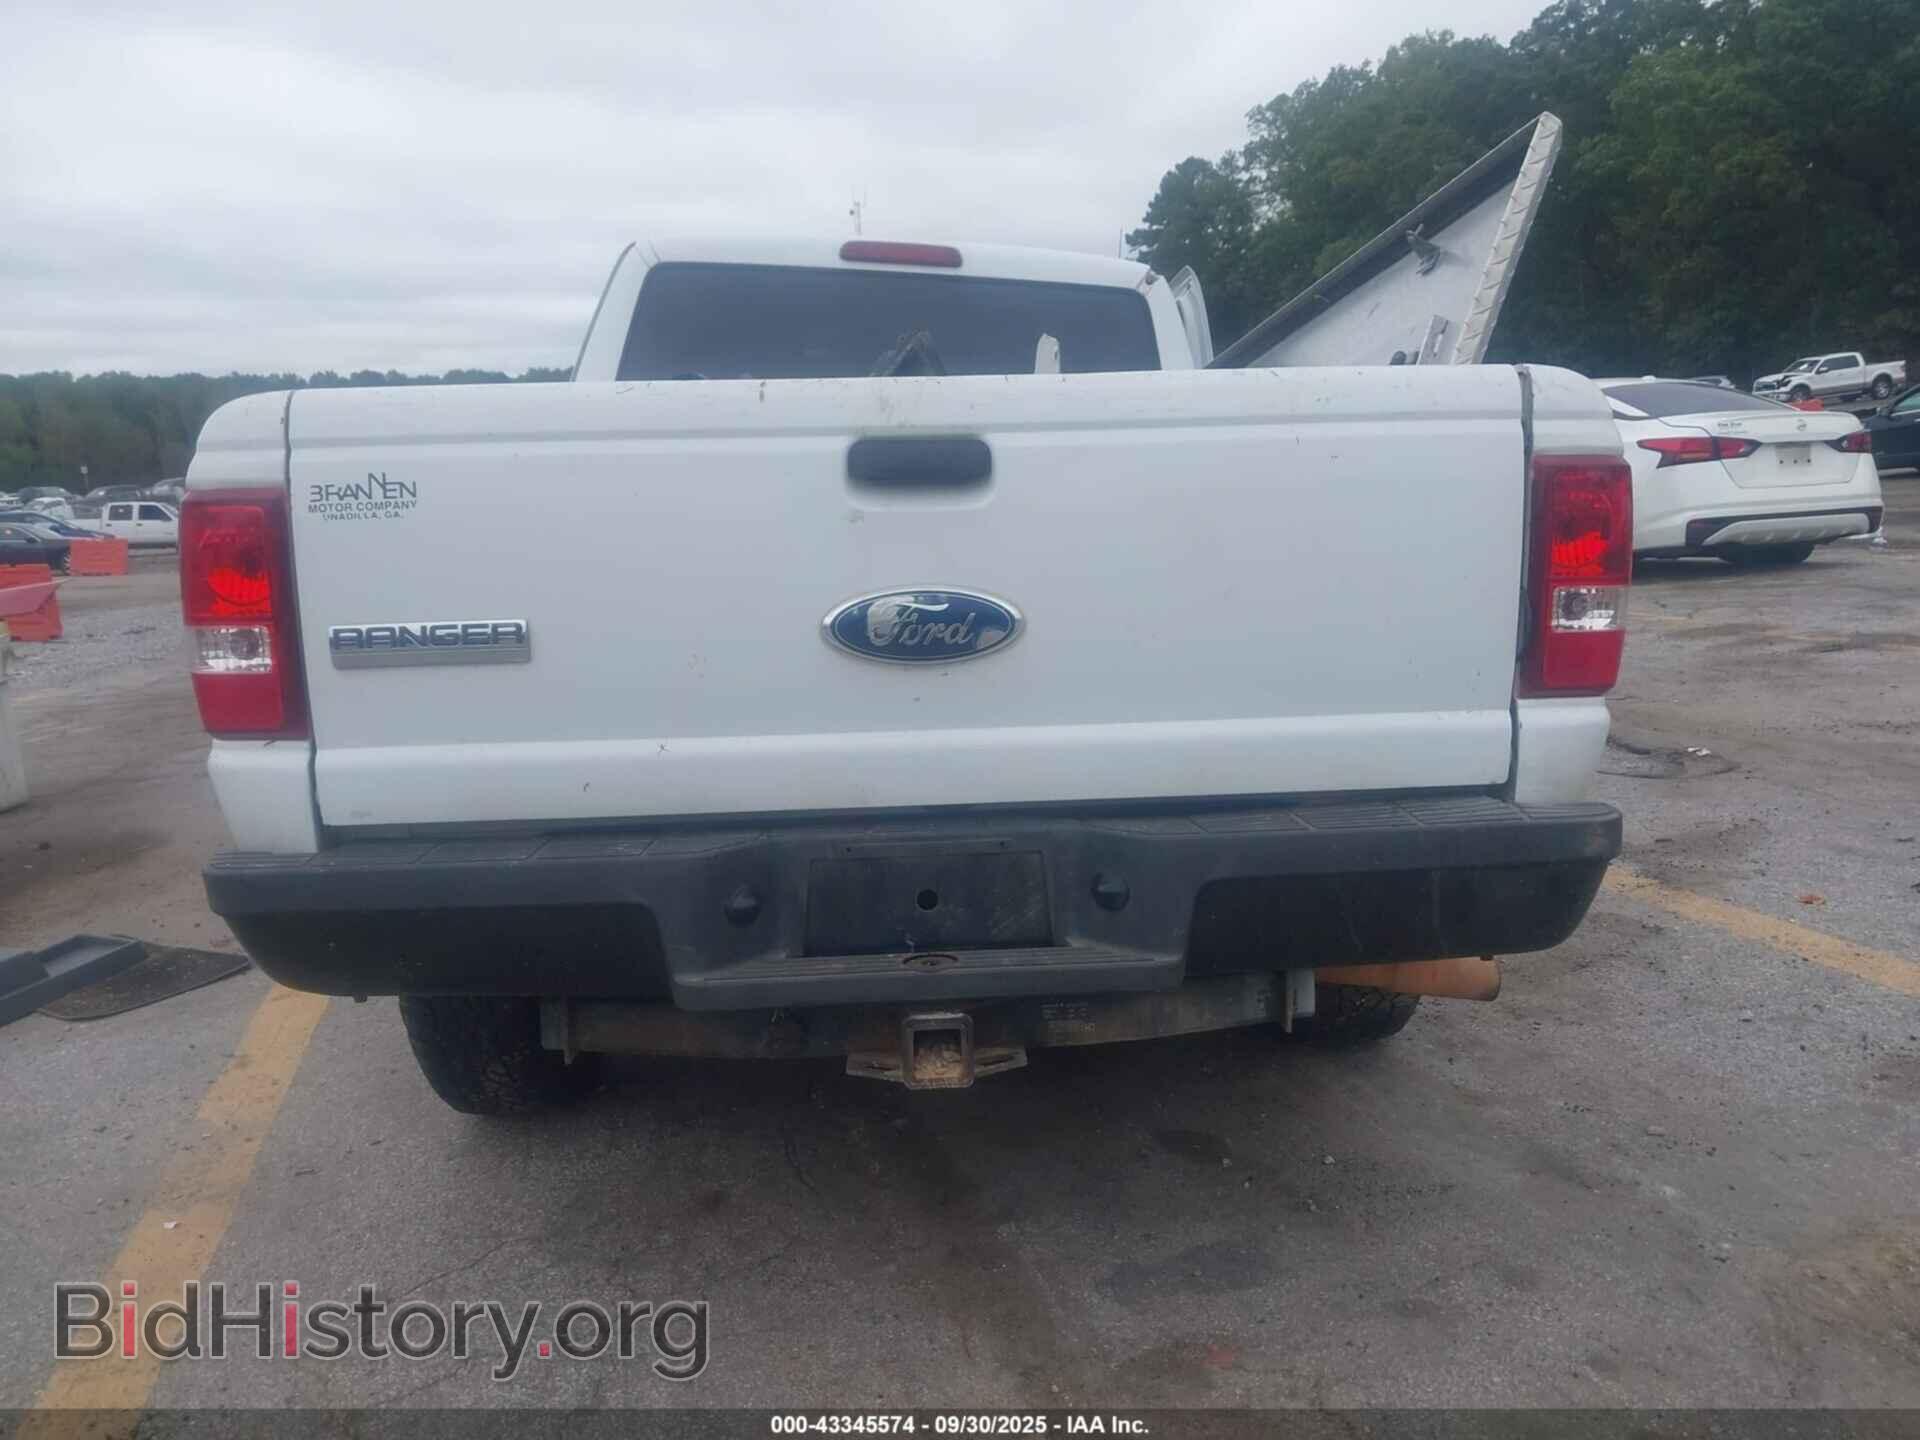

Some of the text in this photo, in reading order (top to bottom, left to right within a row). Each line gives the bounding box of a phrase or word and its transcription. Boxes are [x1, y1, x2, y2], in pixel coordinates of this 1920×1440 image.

[309, 472, 417, 503] BRANNEN
[308, 500, 418, 513] MOTOR COMPANY
[329, 619, 528, 650] RANGER
[867, 597, 976, 647] Ford
